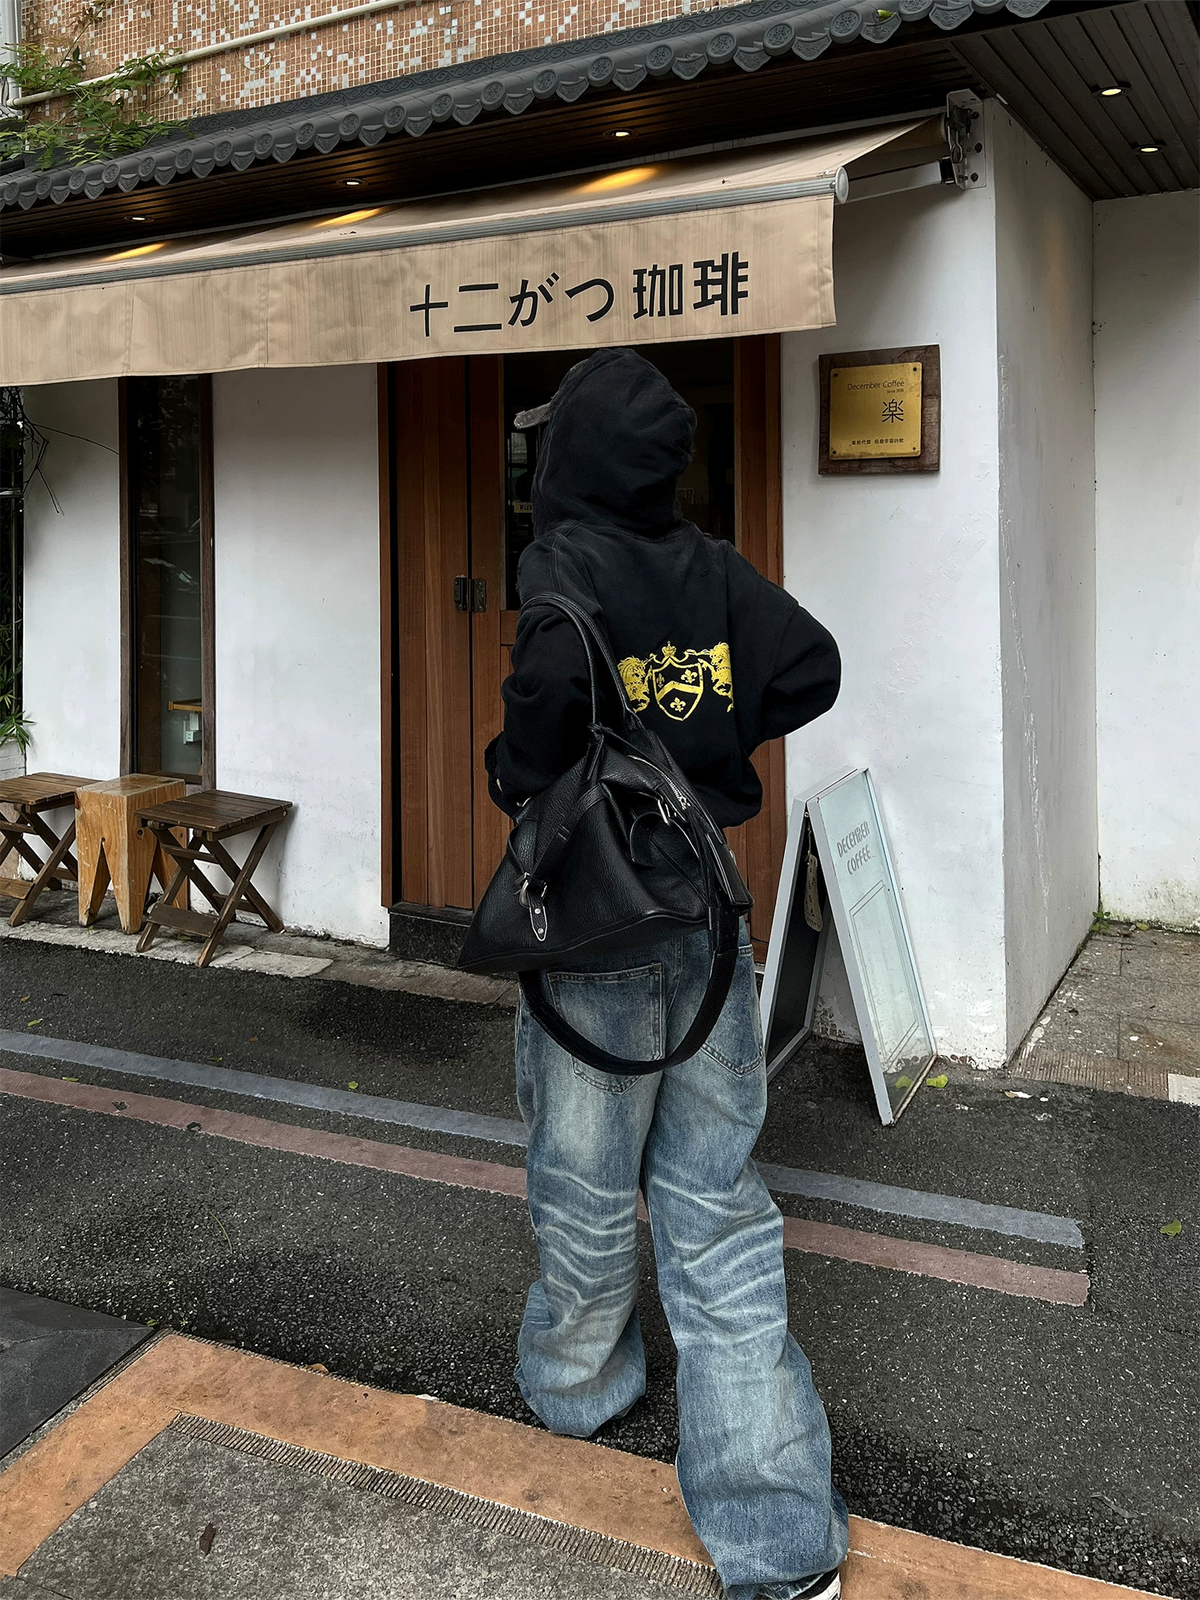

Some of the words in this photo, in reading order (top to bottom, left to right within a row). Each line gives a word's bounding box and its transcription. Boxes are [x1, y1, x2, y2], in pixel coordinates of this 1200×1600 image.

[847, 382, 881, 391] December
[882, 379, 905, 388] Coffee
[882, 399, 904, 423] 楽
[836, 820, 871, 858] DECEMBER
[847, 844, 871, 875] COFFEE
